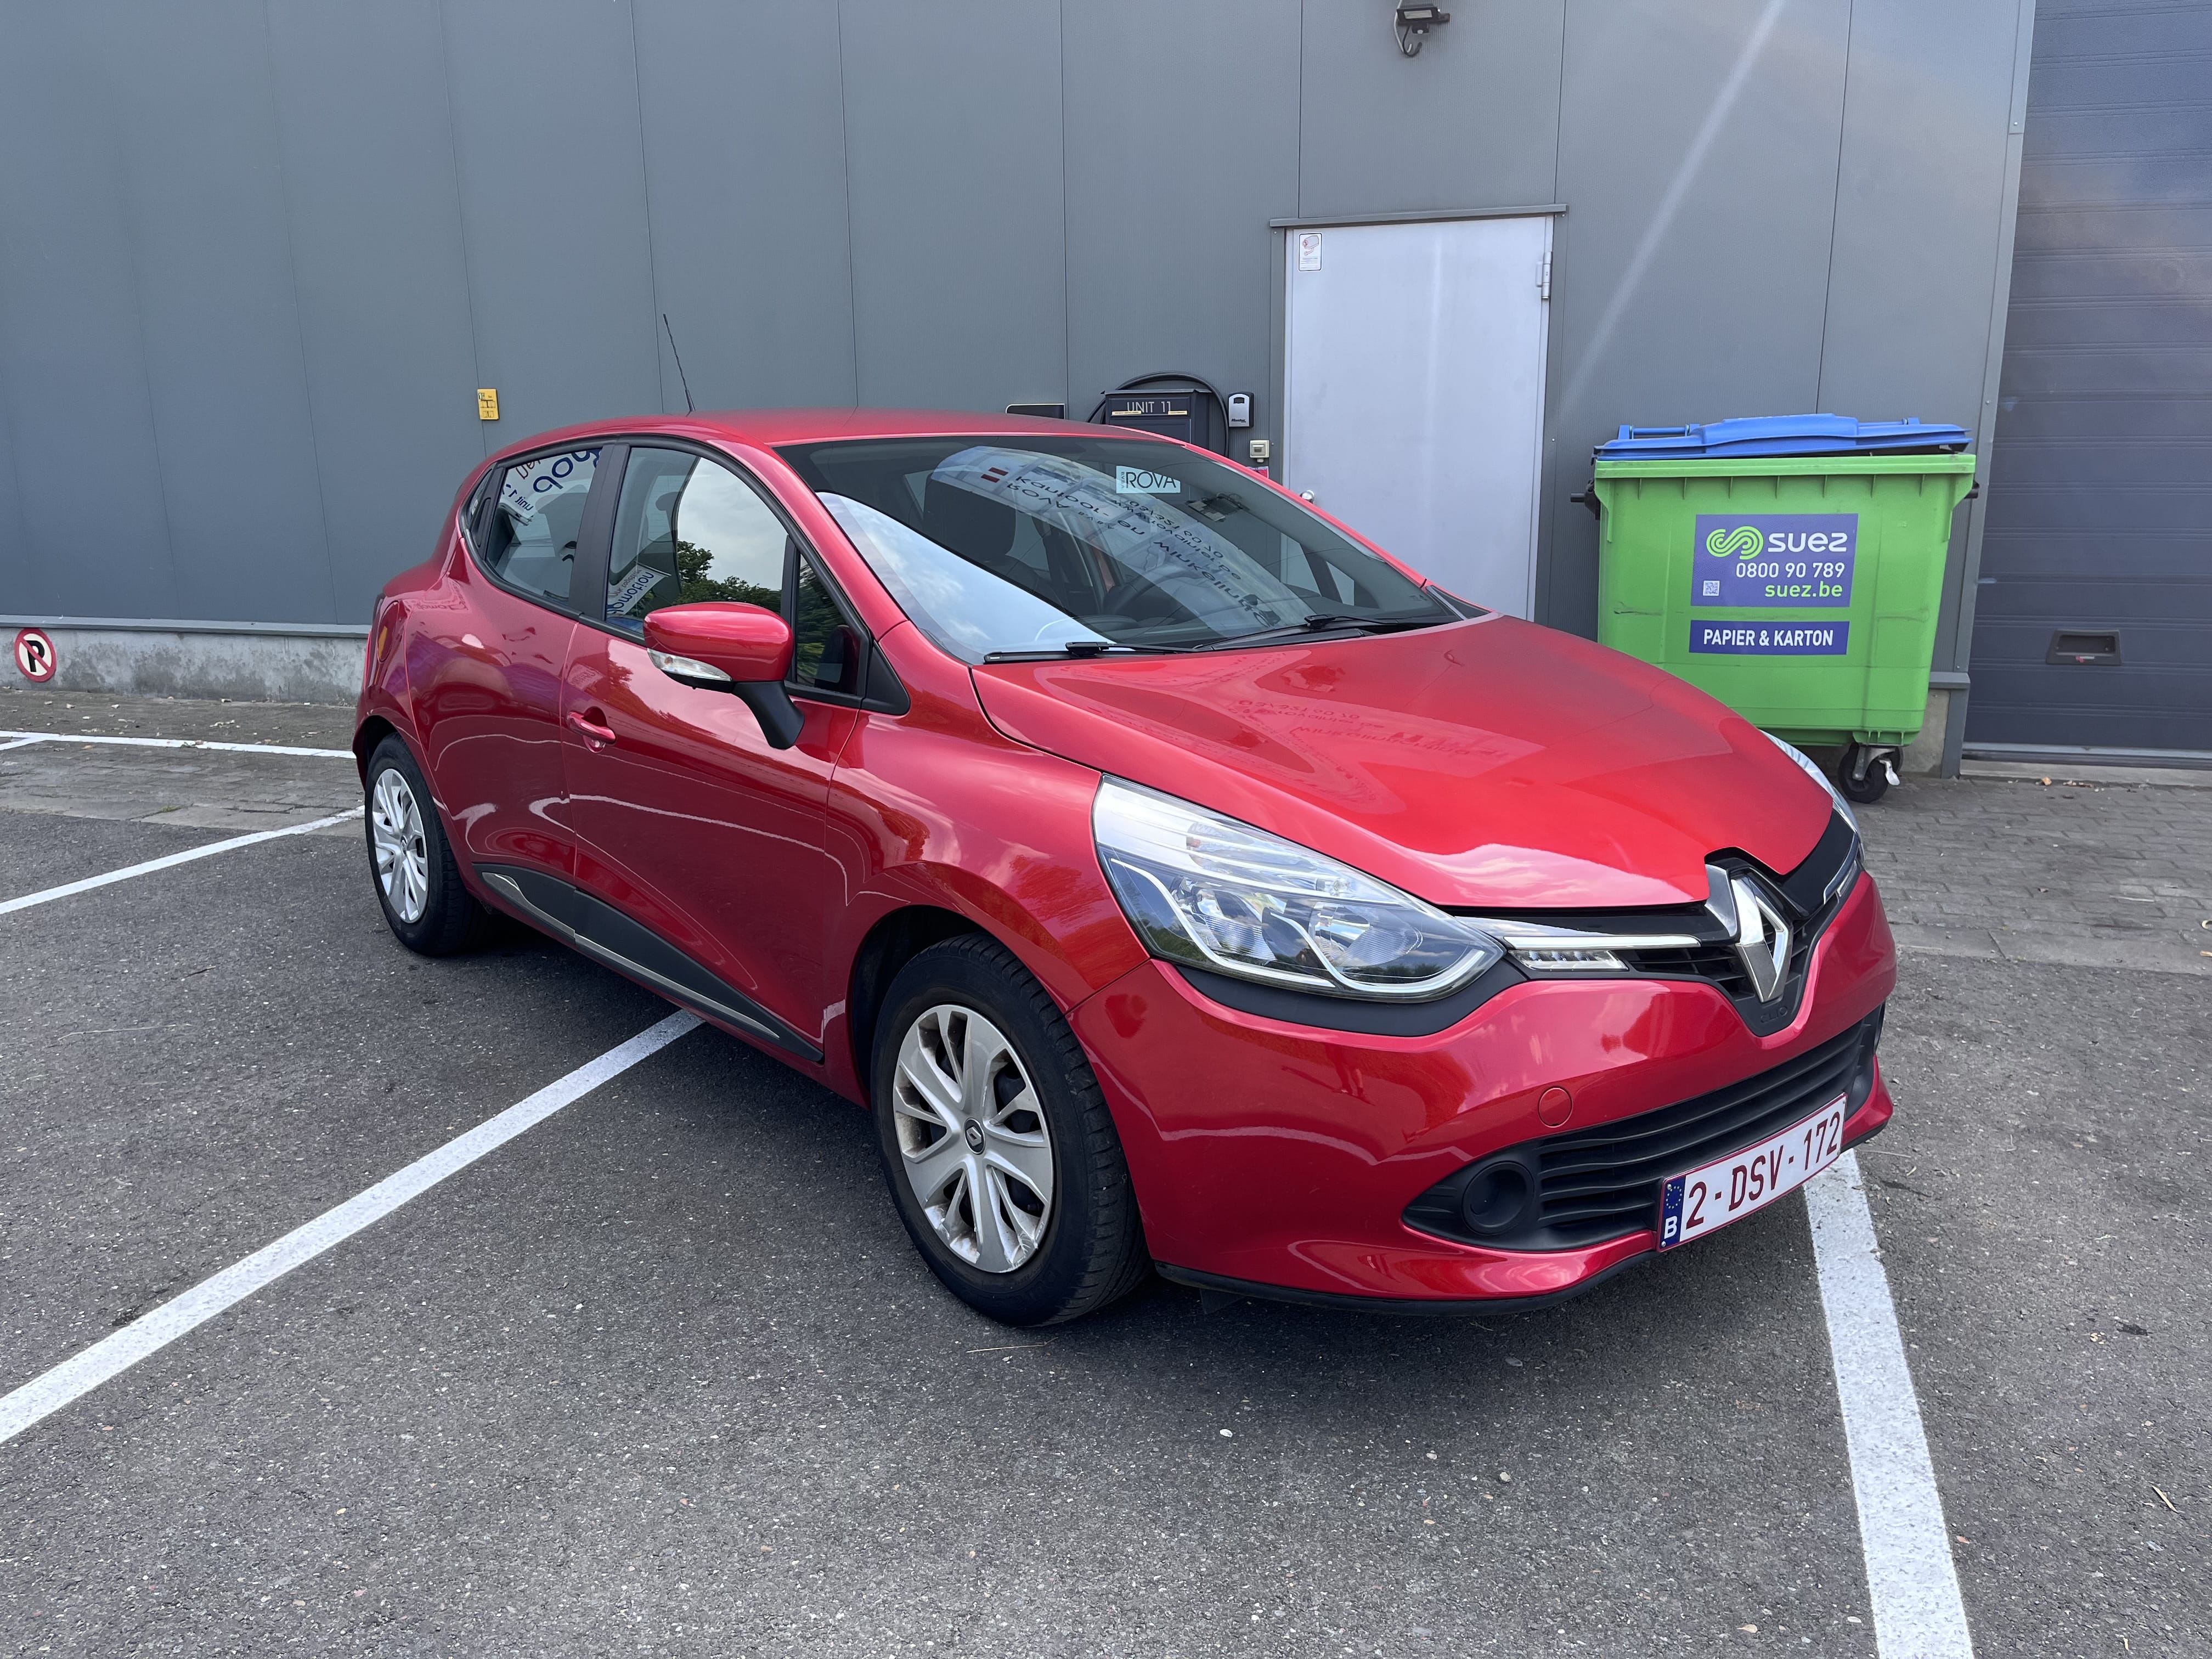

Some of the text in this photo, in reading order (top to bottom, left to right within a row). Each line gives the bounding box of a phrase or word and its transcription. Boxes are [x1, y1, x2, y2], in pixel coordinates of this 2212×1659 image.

[1127, 402, 1171, 413] UNIT 11
[1126, 471, 1176, 488] ROVA
[1768, 532, 1848, 553] suez
[1736, 562, 1845, 578] 0800 90 789
[1764, 580, 1843, 597] suez.be
[1703, 629, 1833, 647] PAPIER & KARTON
[26, 640, 45, 673] P
[1760, 1006, 1788, 1024] CLIO
[1686, 1111, 1841, 1230] 2-DSV-172
[1664, 1215, 1678, 1239] B
